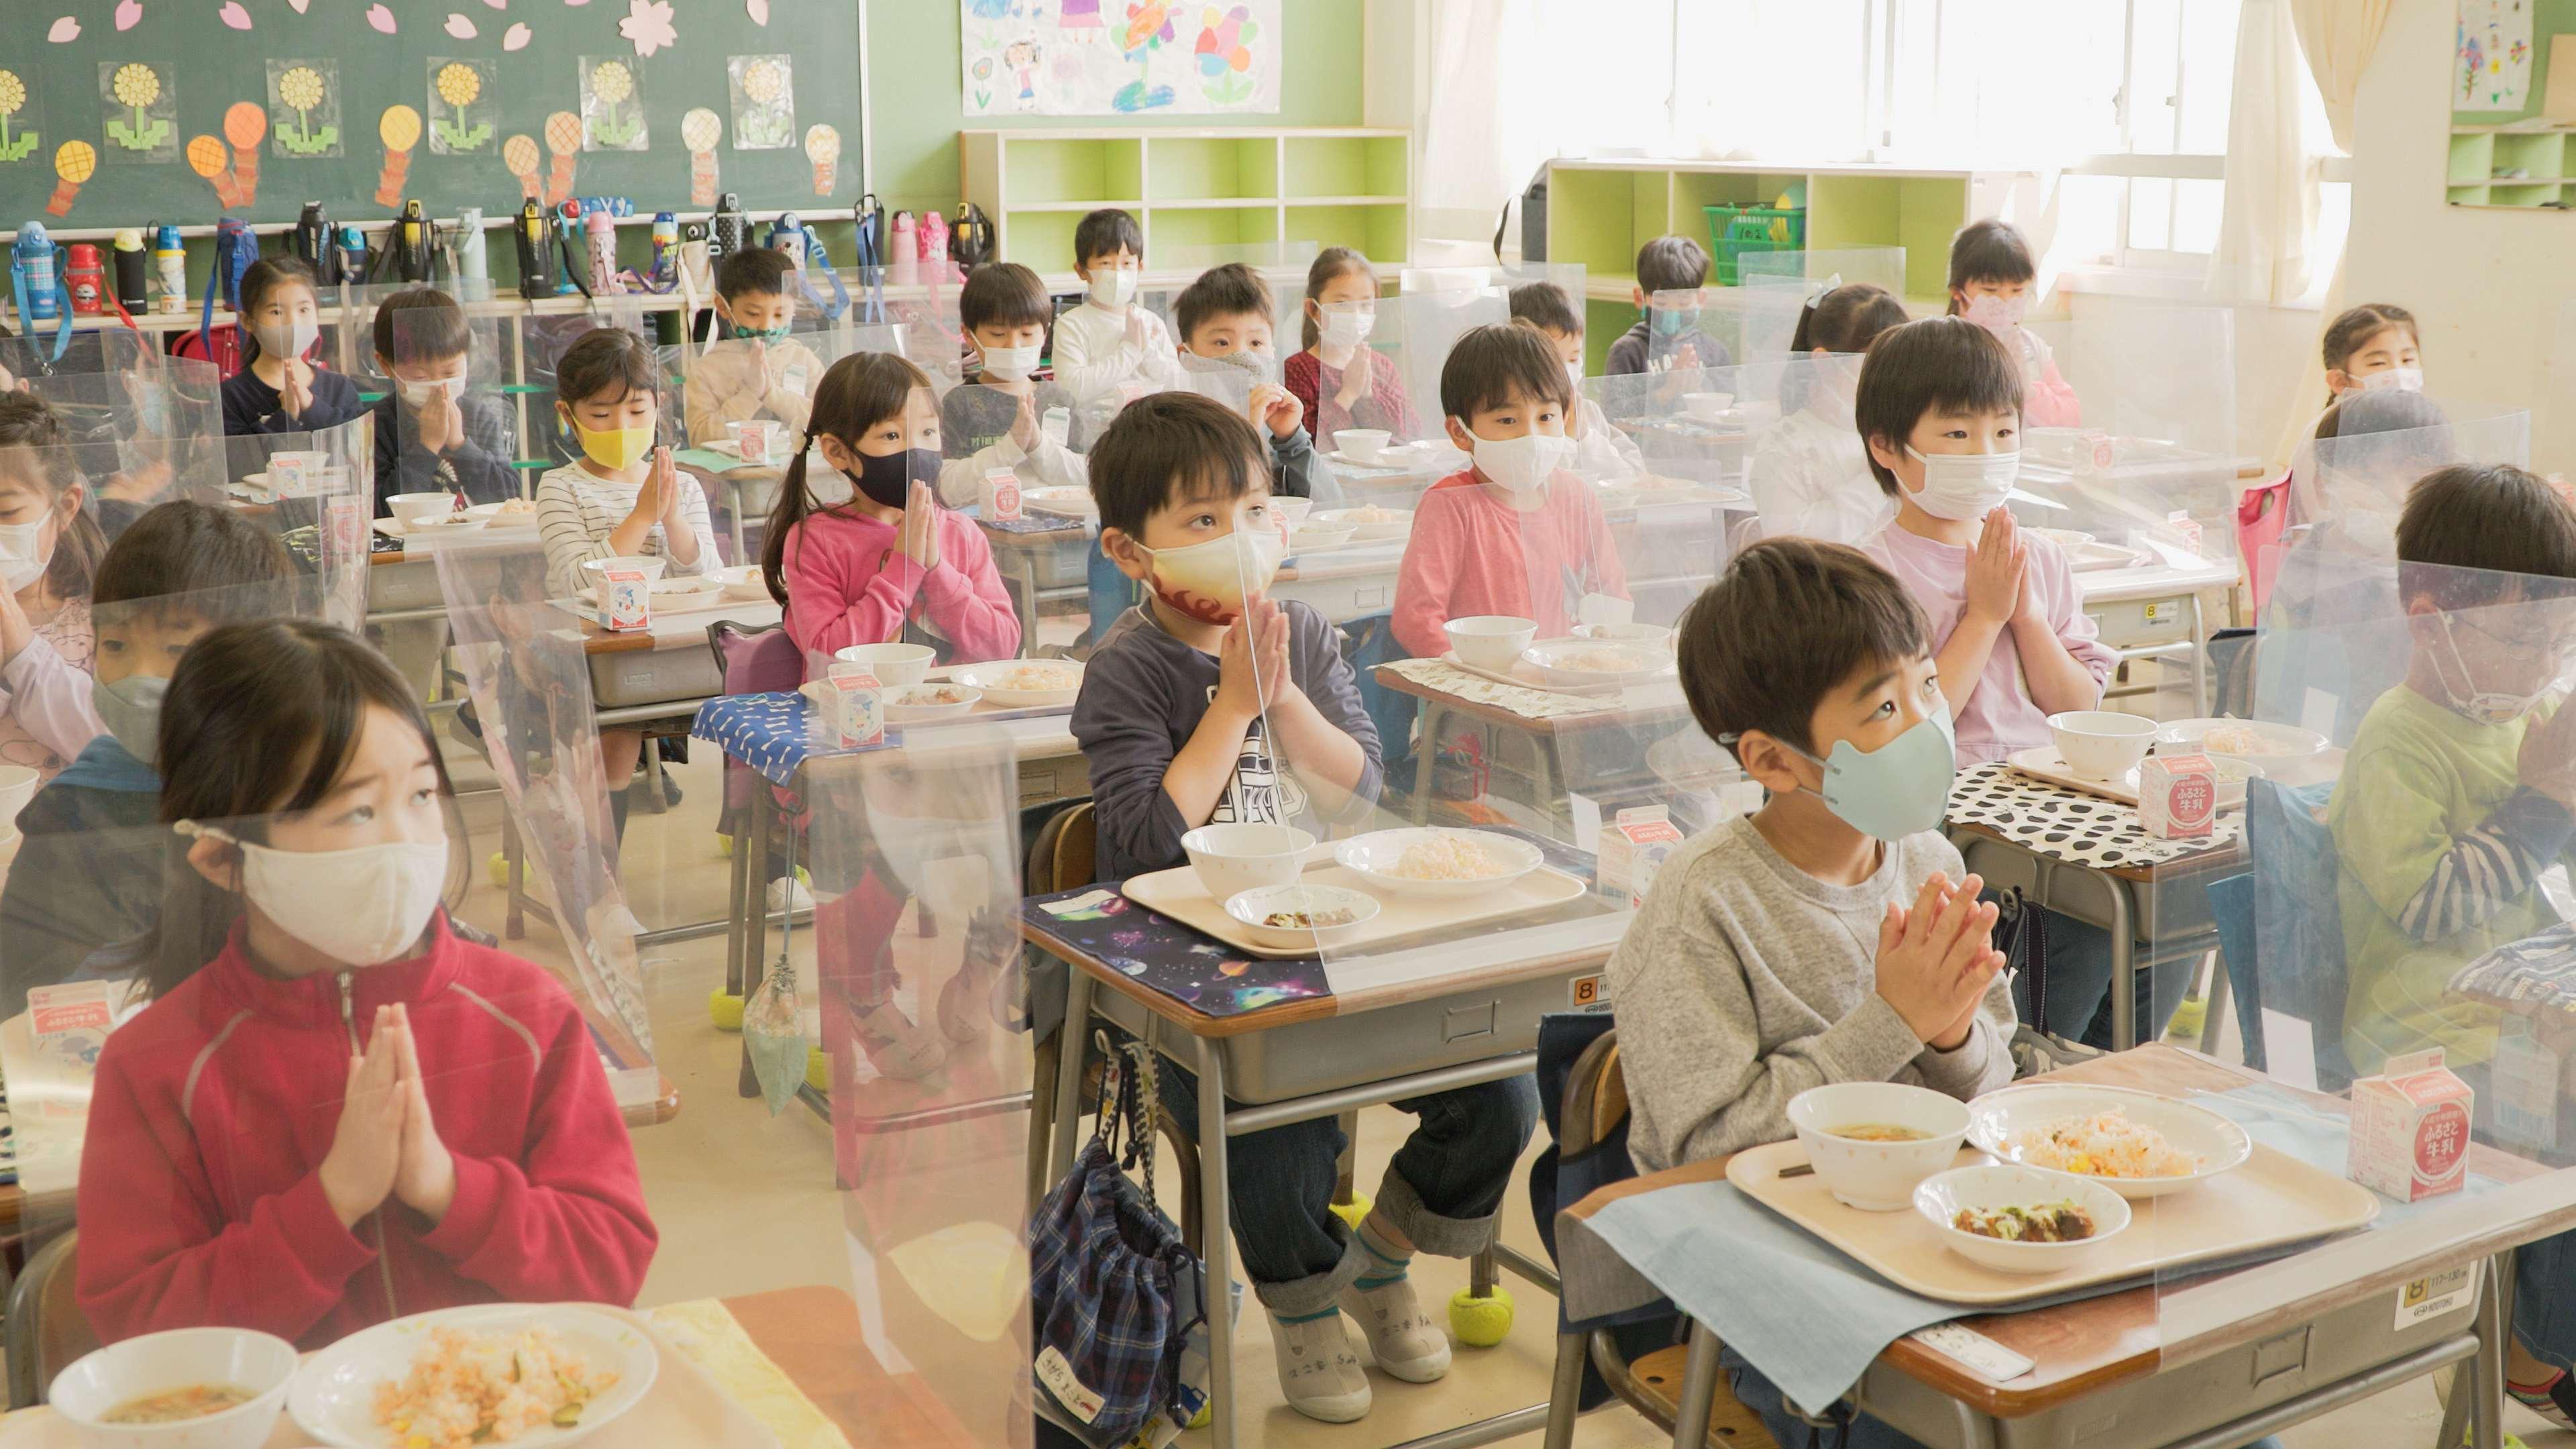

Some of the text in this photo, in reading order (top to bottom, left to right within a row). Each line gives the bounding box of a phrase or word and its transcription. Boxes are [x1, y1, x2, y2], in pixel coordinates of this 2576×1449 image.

[2147, 606, 2155, 617] 8
[2177, 786, 2206, 800] ふるさと
[2179, 798, 2204, 810] 牛乳
[1579, 982, 1593, 1000] 8
[2424, 1120, 2459, 1143] ふるさと
[2426, 1138, 2455, 1158] 牛乳
